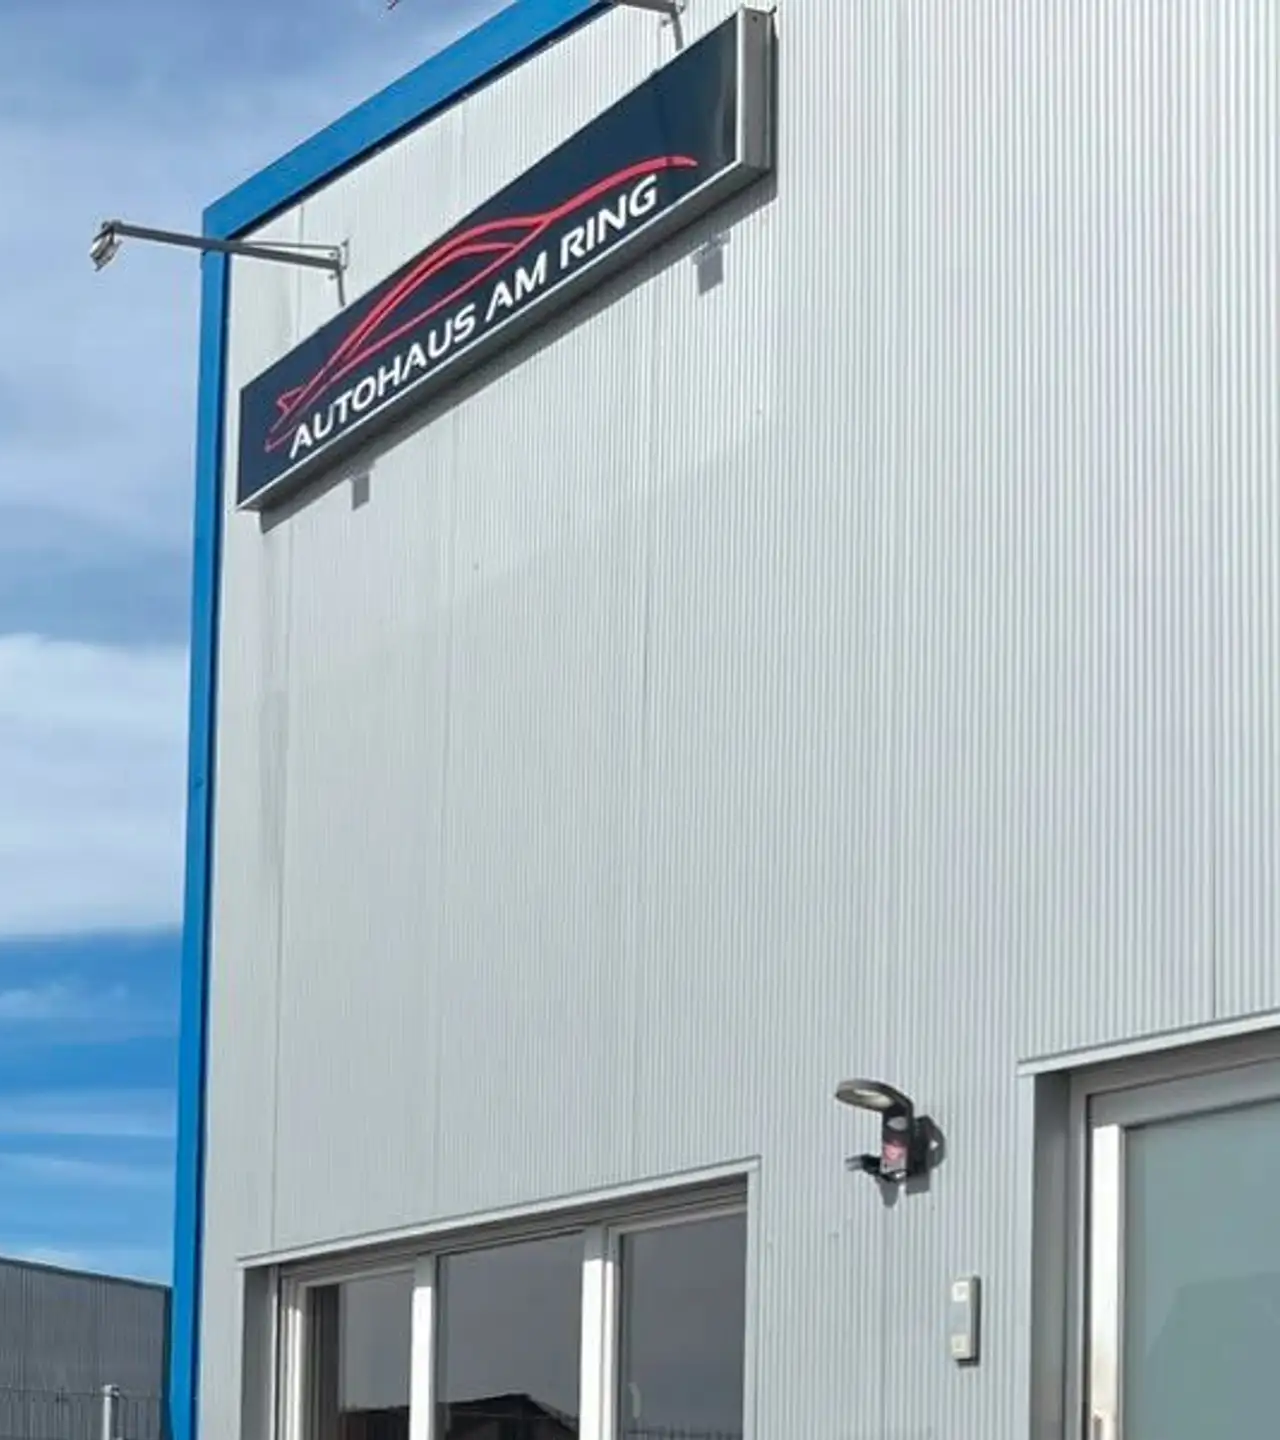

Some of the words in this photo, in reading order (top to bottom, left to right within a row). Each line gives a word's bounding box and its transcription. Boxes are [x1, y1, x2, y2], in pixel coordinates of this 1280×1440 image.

[290, 305, 476, 458] AUTOHAUS
[486, 252, 548, 322] AM
[560, 175, 657, 269] RING
